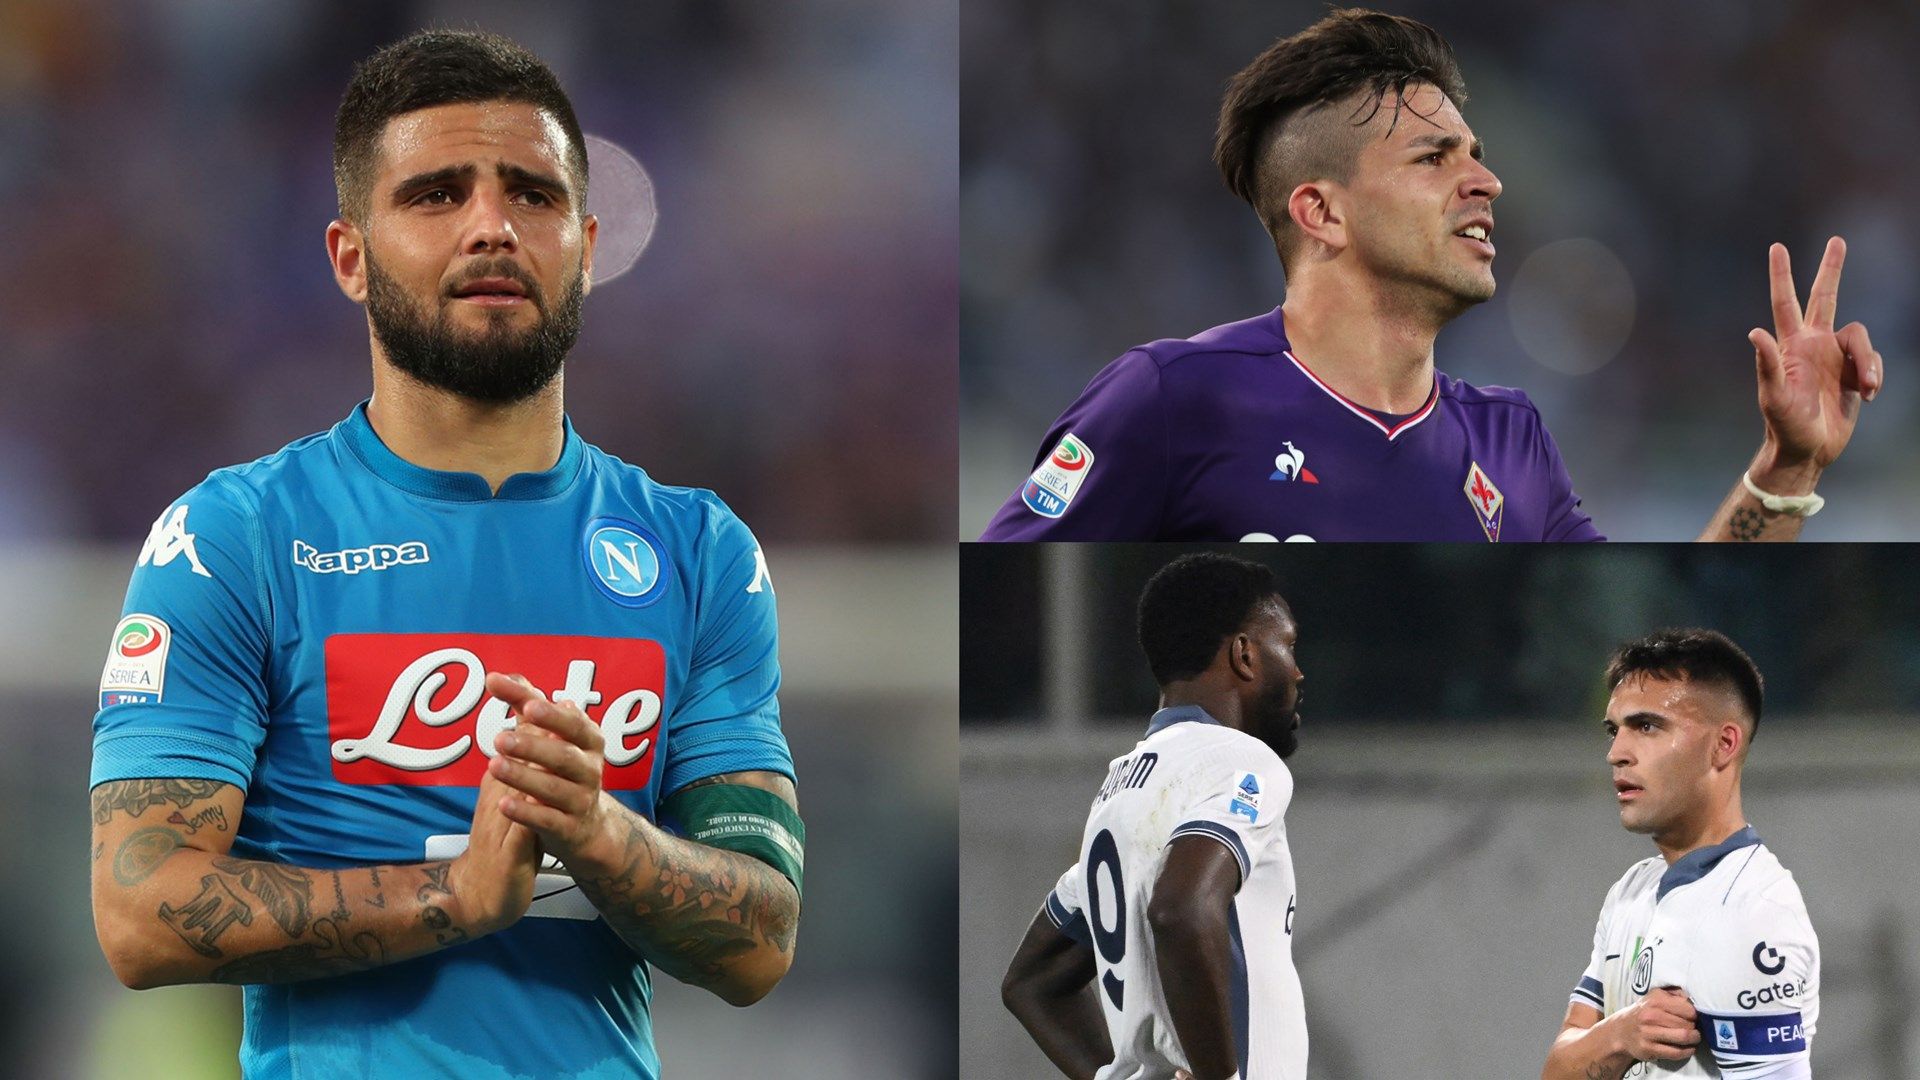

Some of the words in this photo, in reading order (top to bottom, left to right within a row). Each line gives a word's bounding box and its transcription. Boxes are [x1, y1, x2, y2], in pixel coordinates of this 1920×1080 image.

[1060, 482, 1068, 494] A
[1037, 490, 1060, 512] TIM
[599, 540, 643, 584] N
[108, 668, 138, 684] SERIE
[139, 670, 151, 685] A
[706, 815, 737, 826] VALORE.
[695, 827, 723, 839] COLORE.
[724, 824, 749, 832] UNICO
[1087, 828, 1127, 1012] 9
